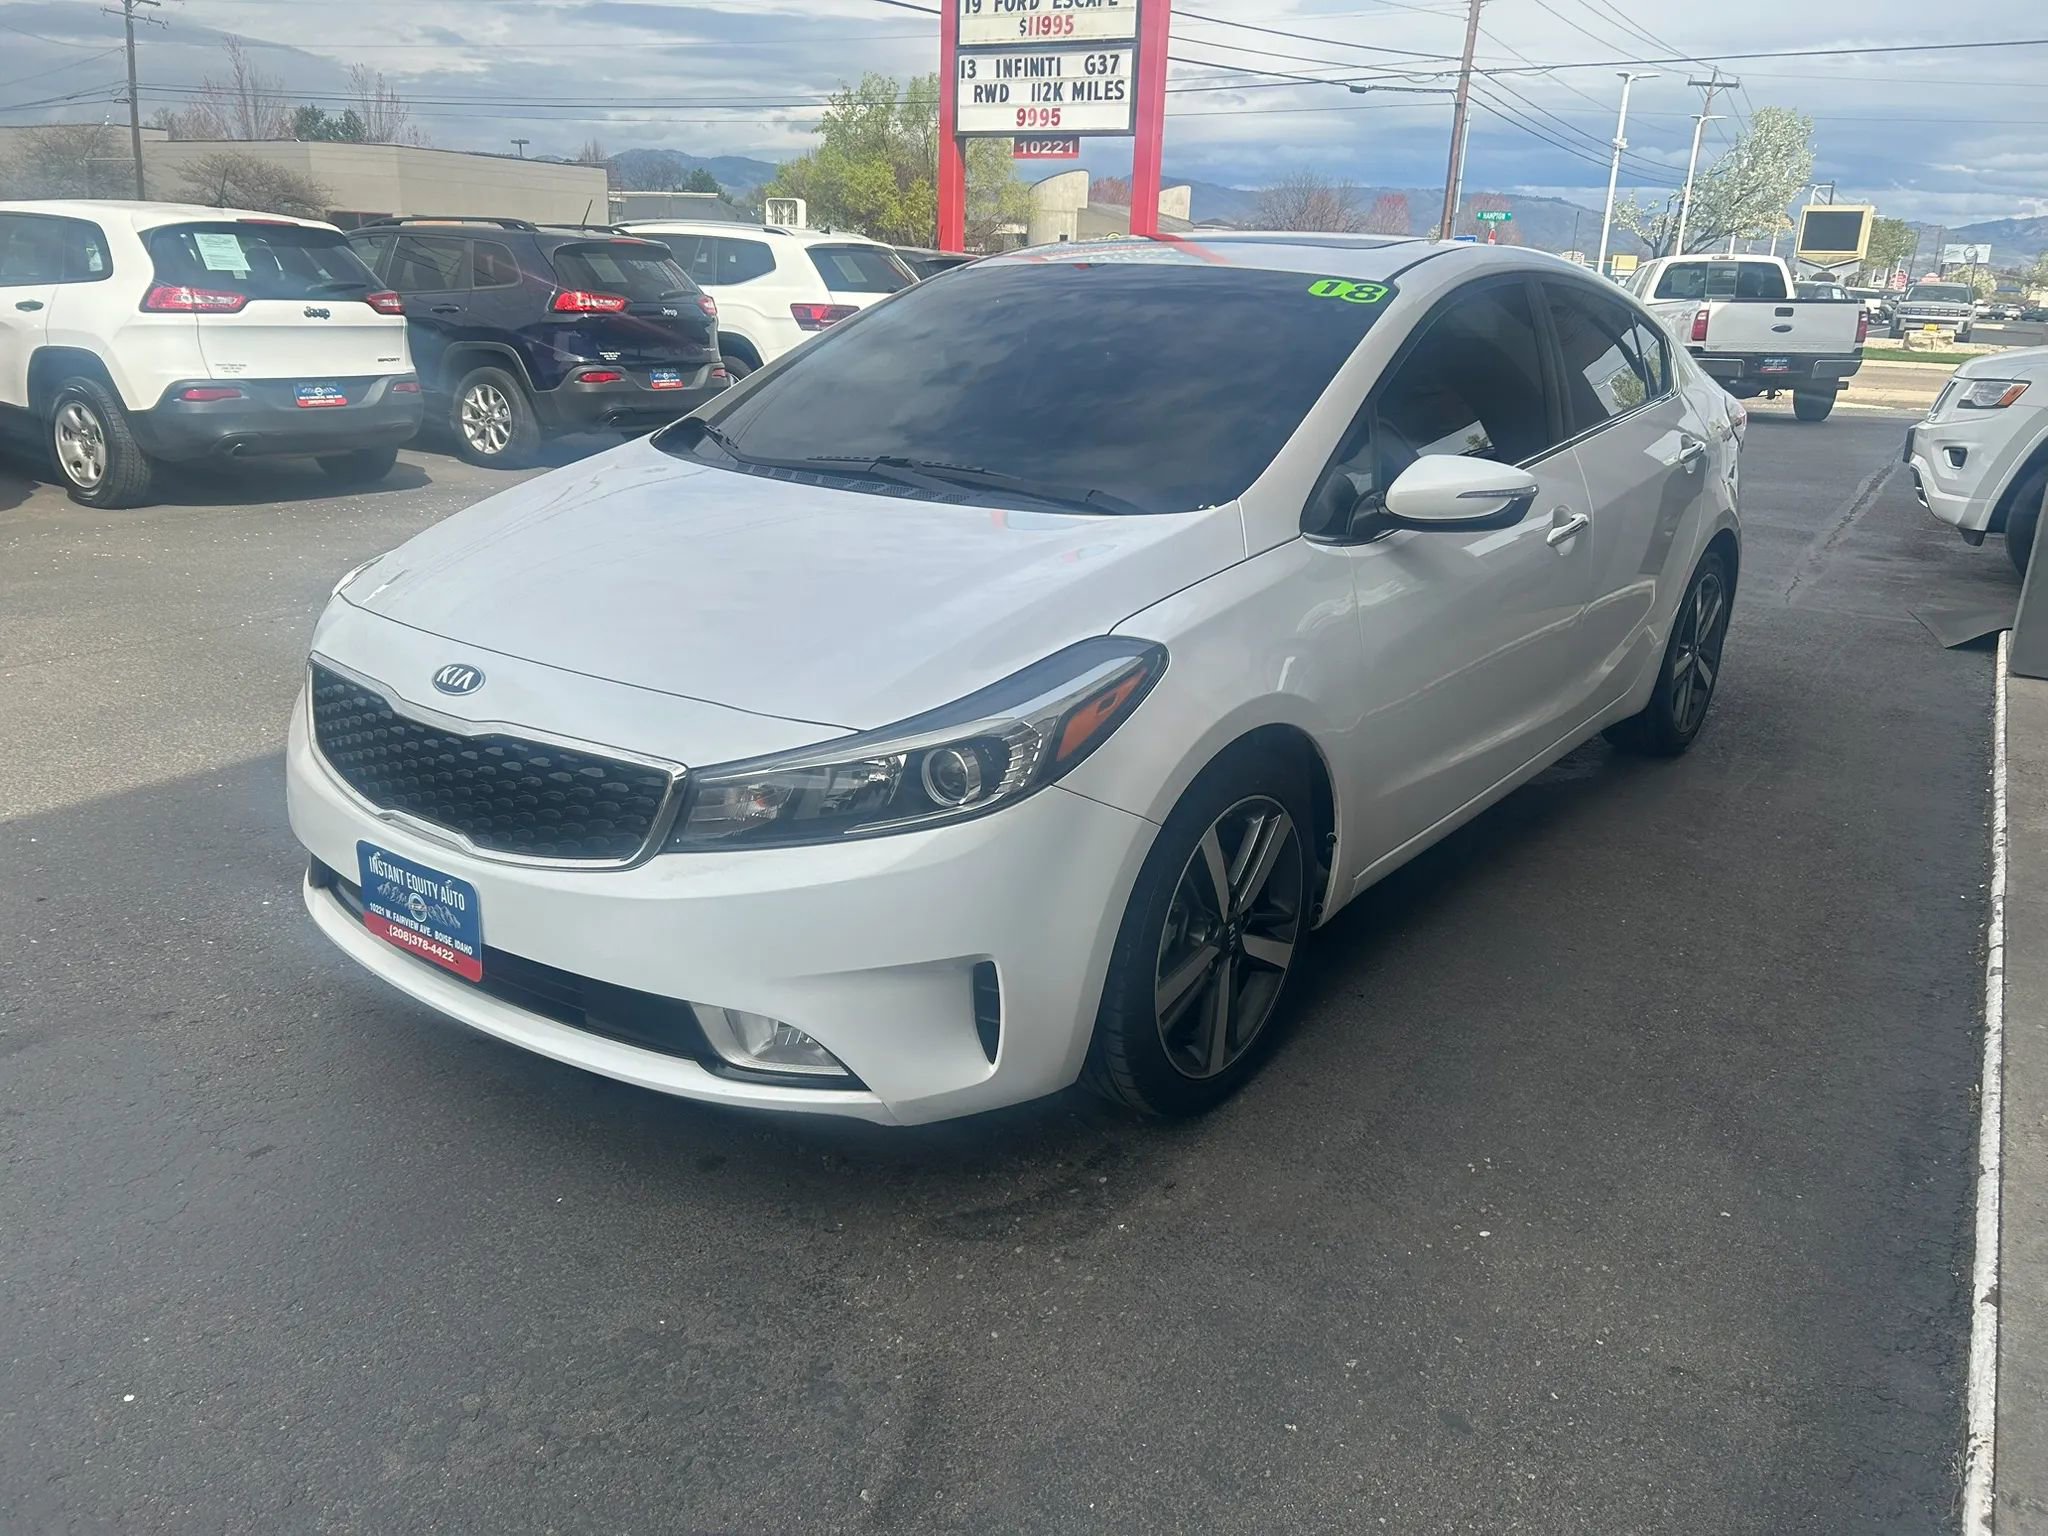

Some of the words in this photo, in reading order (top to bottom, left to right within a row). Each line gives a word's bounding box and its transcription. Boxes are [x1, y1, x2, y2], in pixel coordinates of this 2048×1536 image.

[965, 0, 981, 14] 19
[994, 0, 1040, 12] FORD
[1019, 15, 1074, 36] $11995
[961, 59, 976, 79] 13
[996, 57, 1061, 78] INFINITI
[1084, 54, 1120, 75] G37
[974, 84, 1009, 103] RWD
[1031, 82, 1063, 102] 112K
[1072, 80, 1125, 101] MILES
[1016, 107, 1061, 127] 9995
[1019, 140, 1074, 154] 10221
[1320, 281, 1383, 300] 18
[303, 306, 331, 320] Jeep
[436, 665, 475, 690] KIA
[369, 855, 404, 886] INSTANT
[406, 872, 438, 900] EQUITY
[441, 886, 465, 911] AUTO
[369, 902, 385, 915] 10221
[392, 912, 419, 931] FAIRVIEW
[420, 925, 432, 937] AVE.
[454, 939, 473, 955] IDAHO
